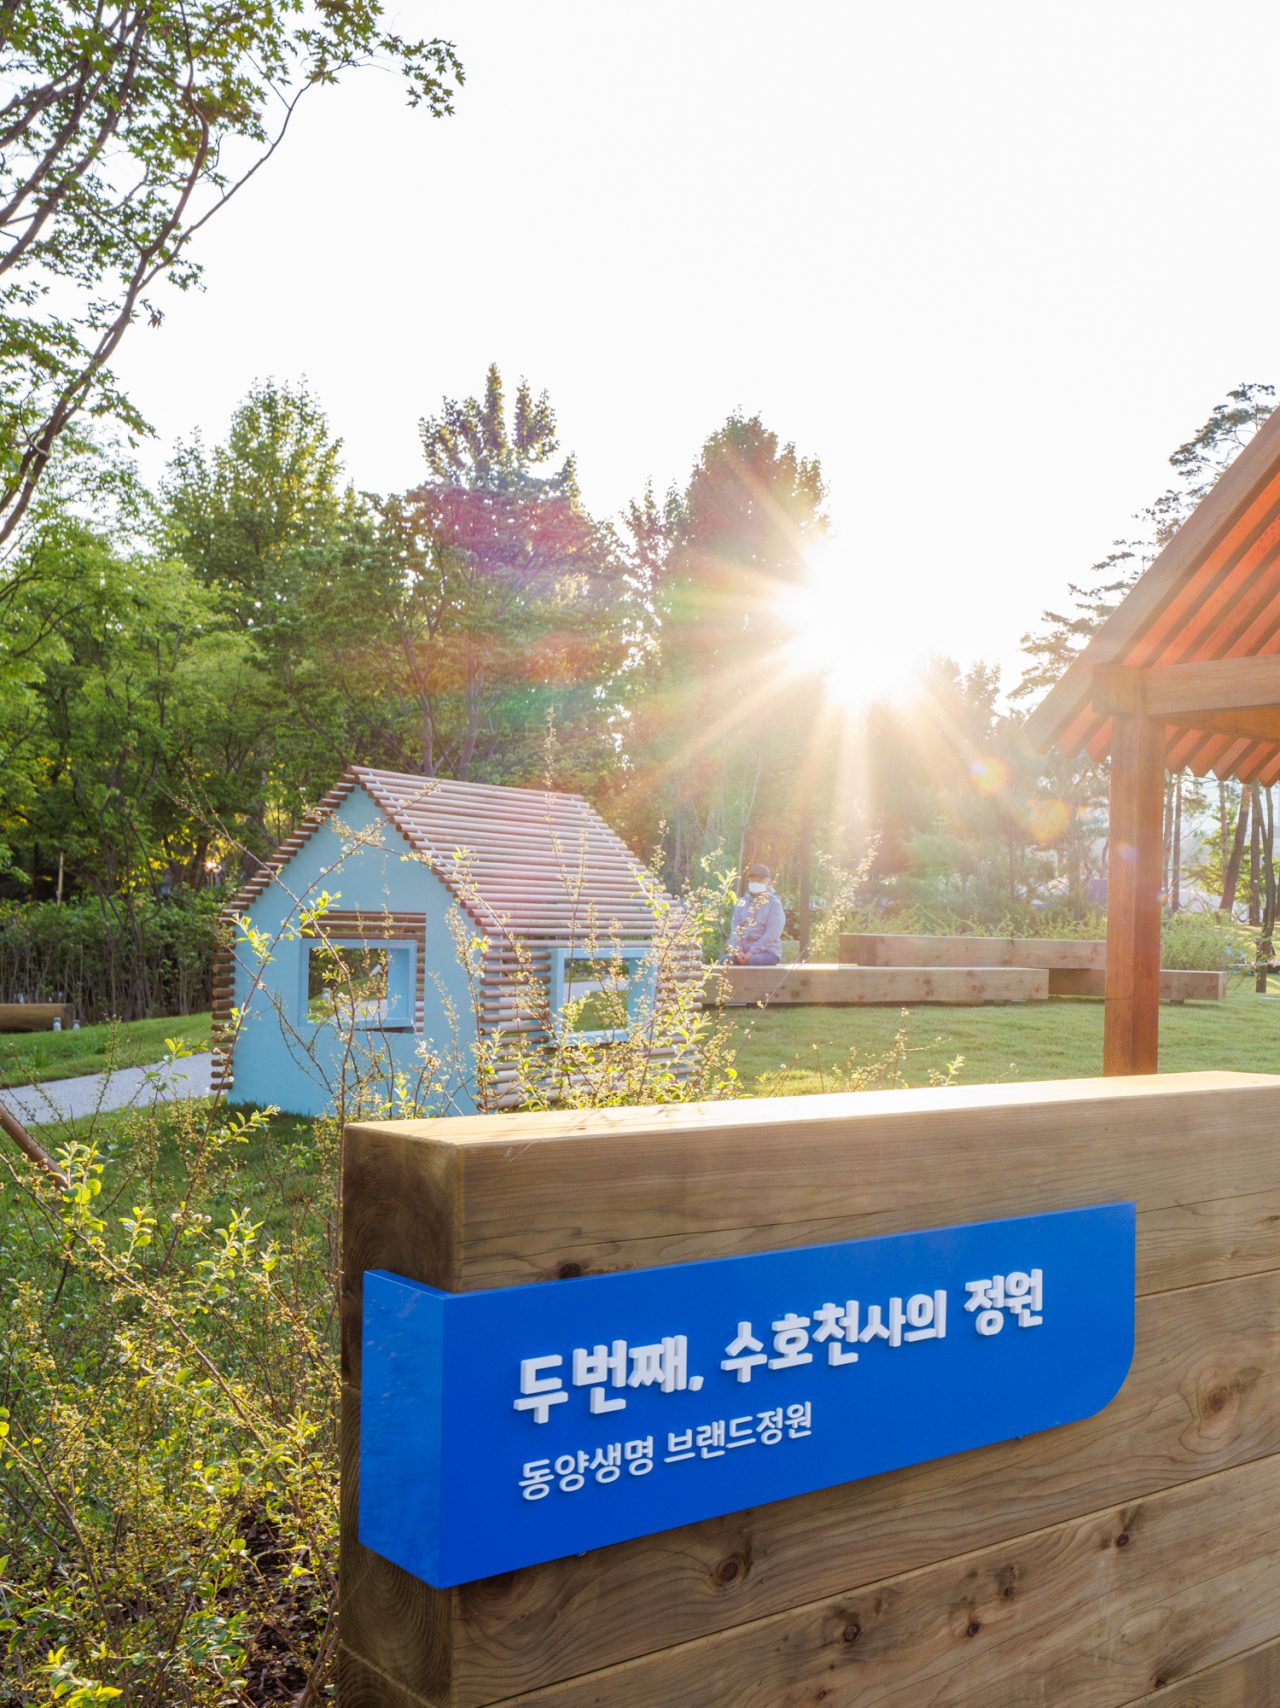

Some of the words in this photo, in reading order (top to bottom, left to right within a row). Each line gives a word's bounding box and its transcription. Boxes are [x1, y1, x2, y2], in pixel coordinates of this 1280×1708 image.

[513, 1334, 705, 1424] 두번째,
[720, 1289, 948, 1383] 수호천사의
[964, 1268, 1044, 1336] 정원
[518, 1435, 655, 1501] 동양생명
[664, 1400, 812, 1464] 브랜드정원
